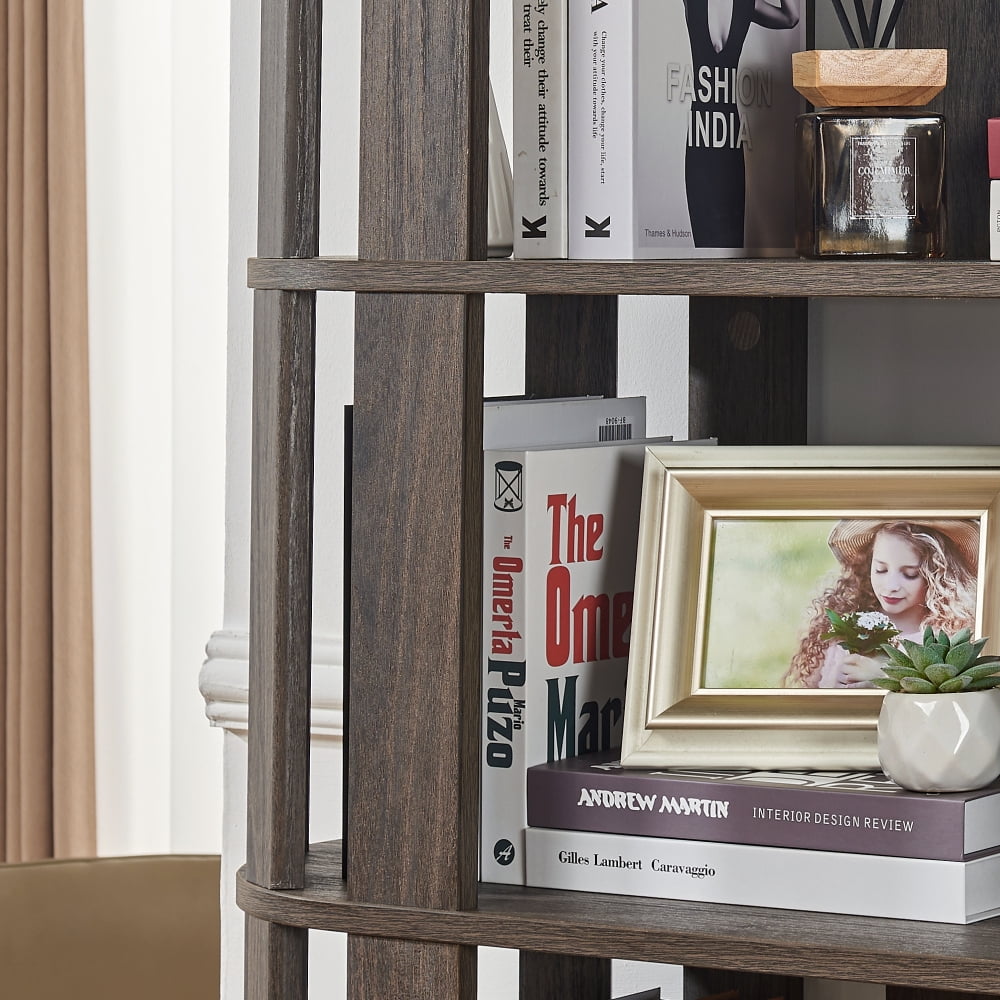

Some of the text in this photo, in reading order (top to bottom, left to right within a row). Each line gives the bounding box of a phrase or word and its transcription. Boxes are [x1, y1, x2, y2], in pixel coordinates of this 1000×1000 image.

[522, 3, 533, 33] treat
[522, 39, 534, 68] their
[535, 20, 548, 65] change
[600, 30, 608, 58] Change
[538, 69, 549, 99] their
[666, 62, 773, 108] FASHION
[538, 103, 549, 153] attitude
[686, 110, 752, 150] INDIA
[538, 158, 549, 207] towards
[521, 215, 547, 239] K
[584, 215, 611, 238] K
[644, 229, 666, 238] Thames
[672, 229, 692, 238] Hudson
[547, 493, 604, 566] The
[491, 536, 523, 655] The Omerta
[486, 656, 527, 769] Puzo
[513, 699, 526, 730] Mario
[546, 674, 627, 764] Mar
[577, 788, 914, 832] ANDREW MARTIN INTERIOR DESIGN REVIEW
[558, 850, 716, 880] Gilles Lambert Caravaggio
